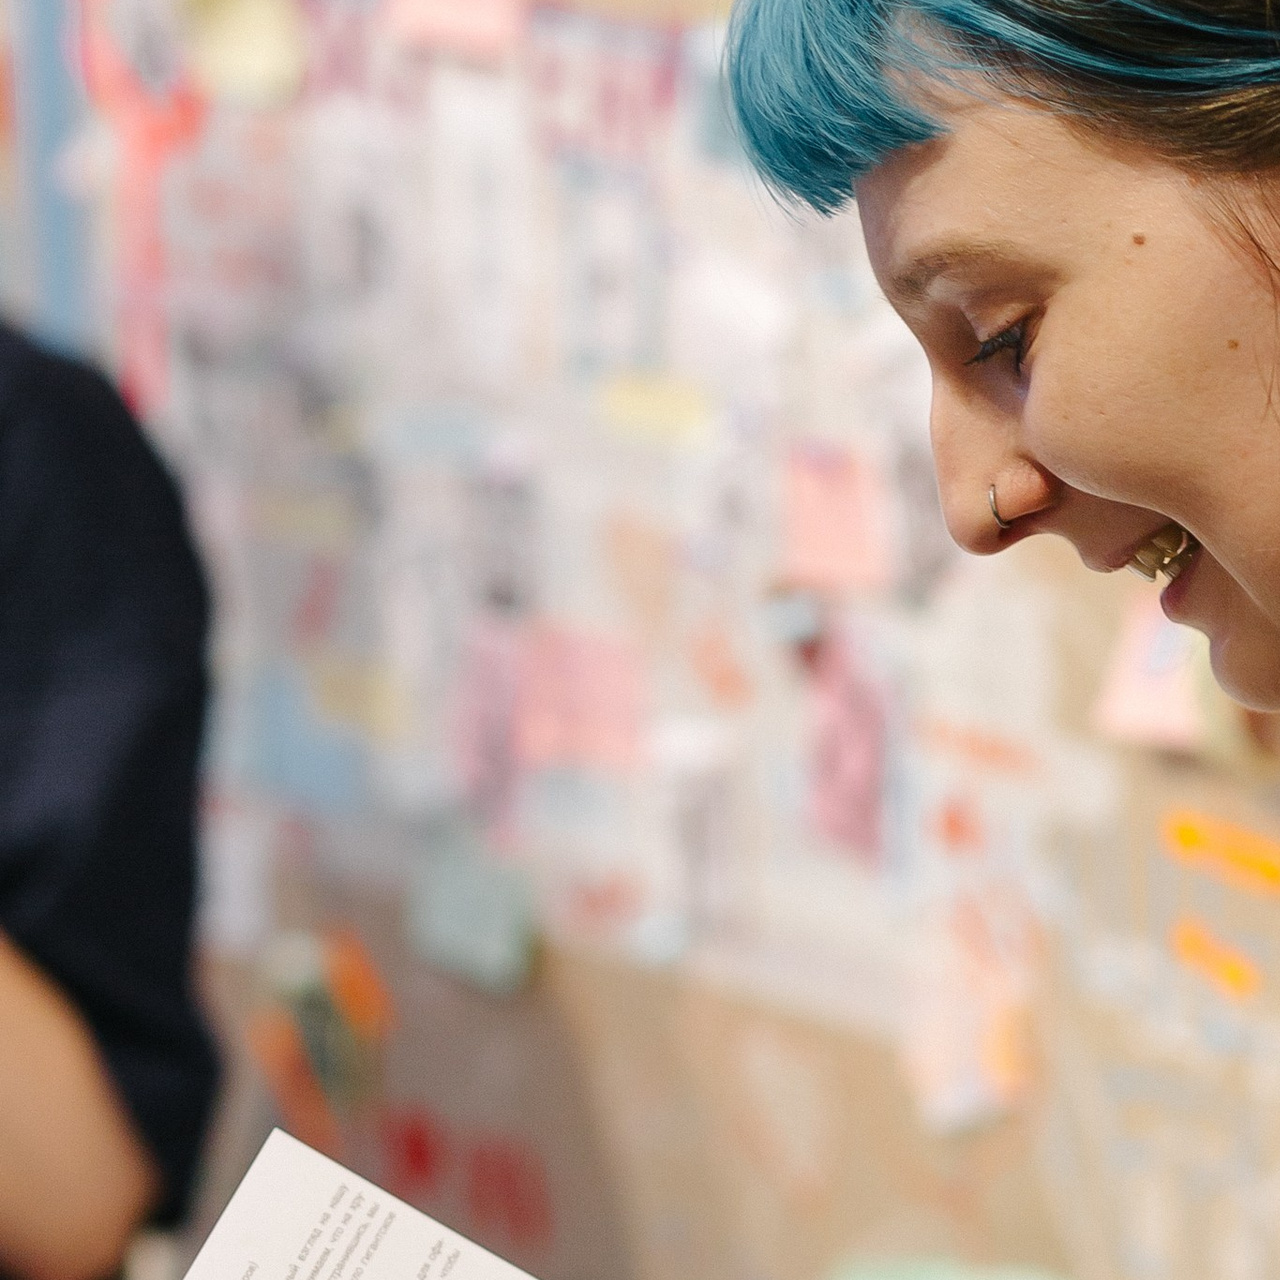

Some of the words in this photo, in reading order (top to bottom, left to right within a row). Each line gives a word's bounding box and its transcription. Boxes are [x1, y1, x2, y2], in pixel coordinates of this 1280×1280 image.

[296, 1227, 323, 1262] взгляд
[318, 1211, 331, 1225] на
[328, 1183, 349, 1210] нашу
[366, 1202, 380, 1218] мы
[329, 1225, 344, 1244] что
[340, 1212, 352, 1225] на
[438, 1248, 461, 1279] чтобы
